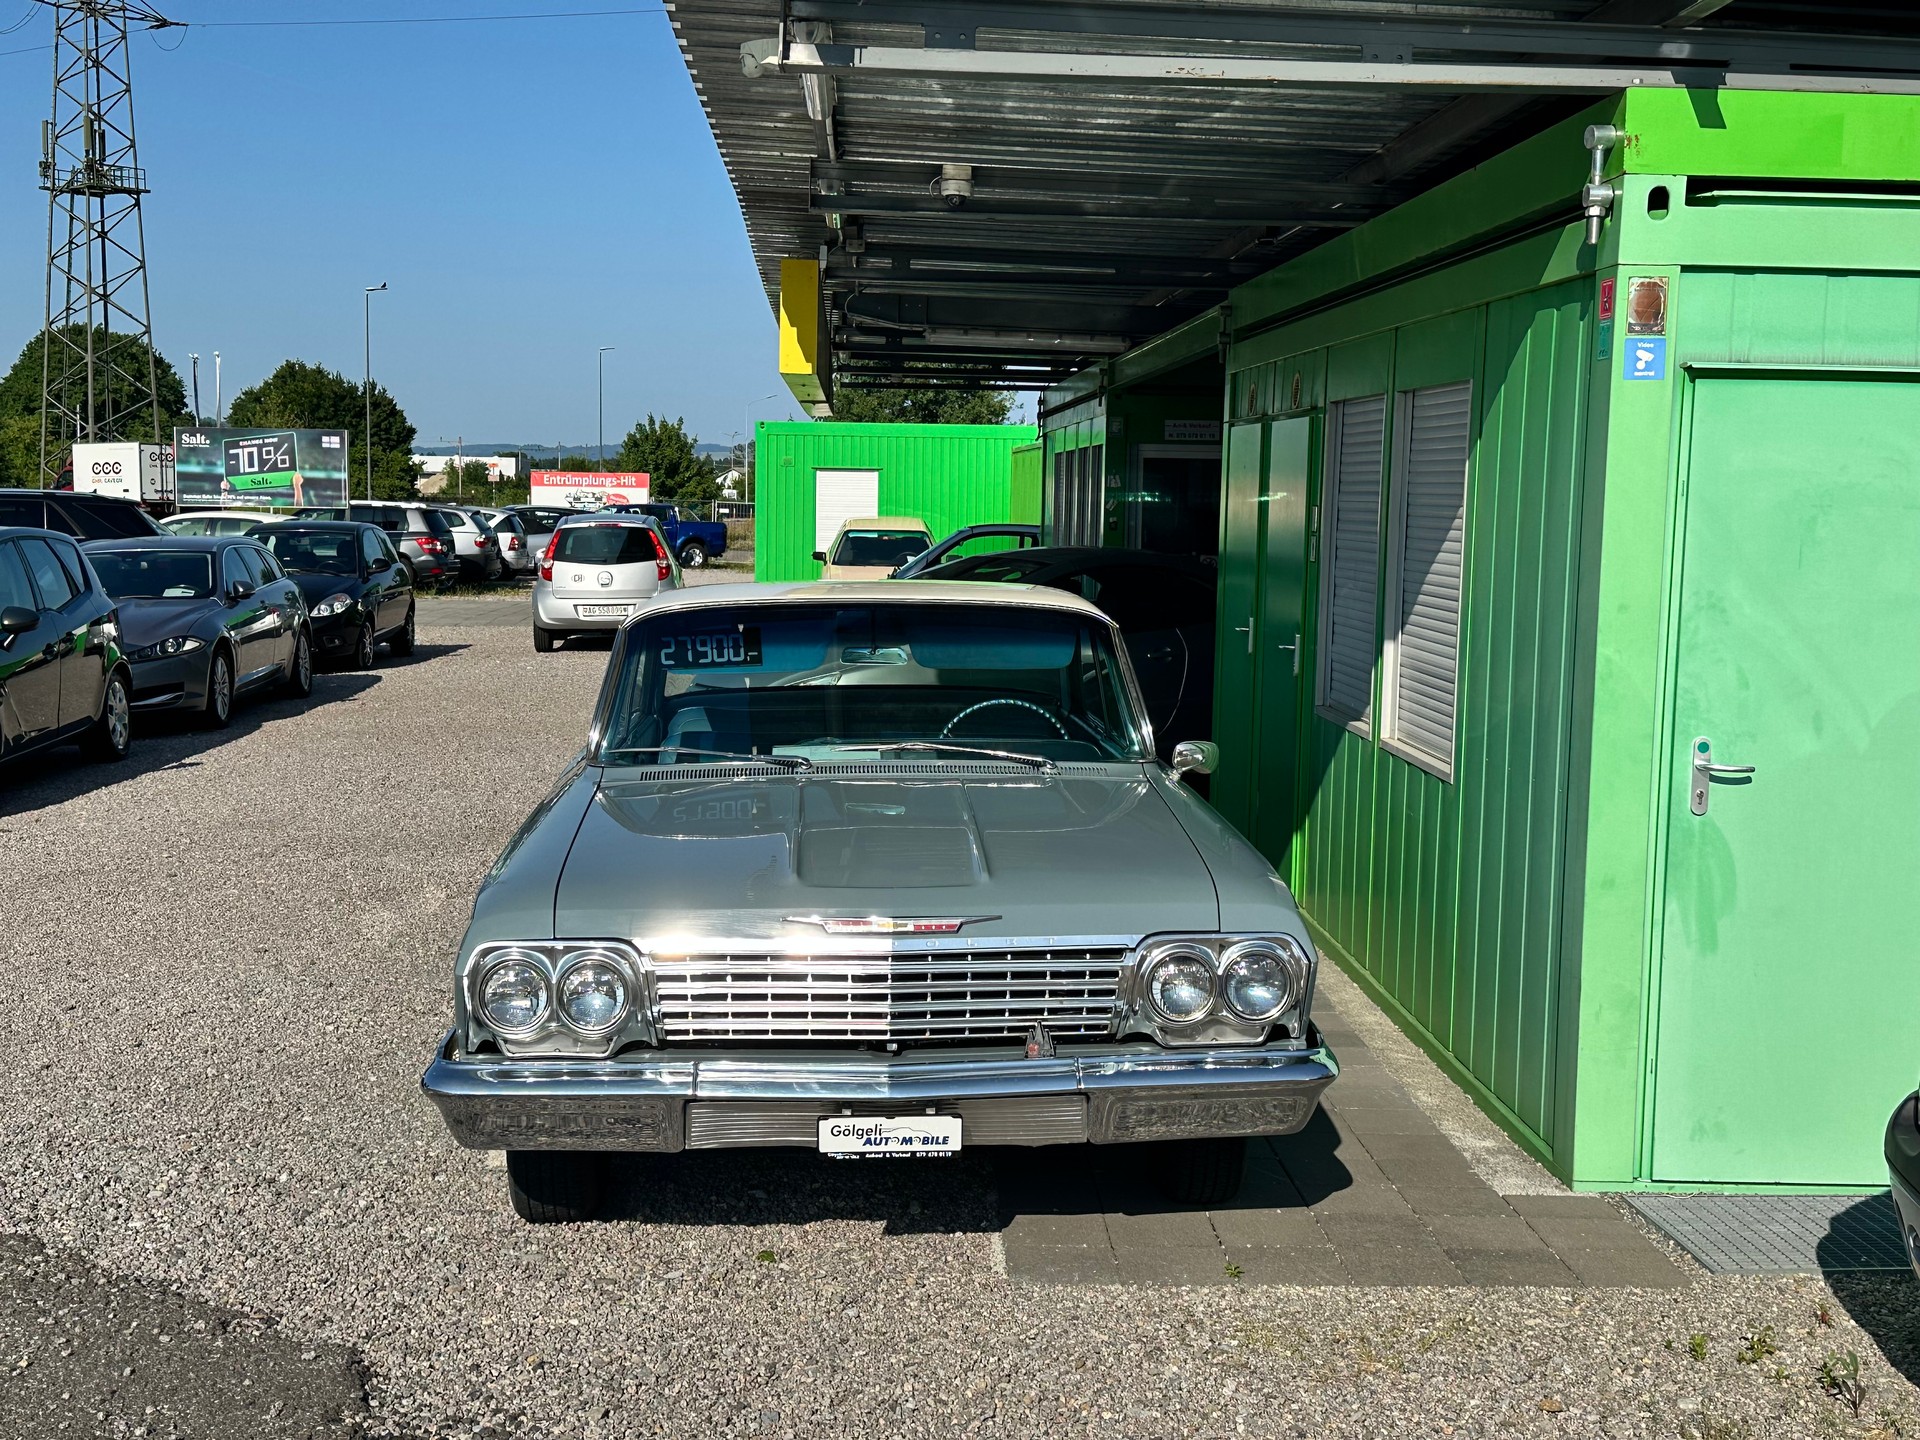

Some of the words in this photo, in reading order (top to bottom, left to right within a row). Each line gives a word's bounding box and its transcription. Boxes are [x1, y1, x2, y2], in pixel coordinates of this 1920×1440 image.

[181, 433, 211, 444] Salt.
[250, 477, 272, 486] Salt.
[543, 474, 636, 487] Entrümplungs-Hit
[830, 1123, 882, 1140] Gölgeli
[862, 1135, 950, 1147] AUTOMOBILE
